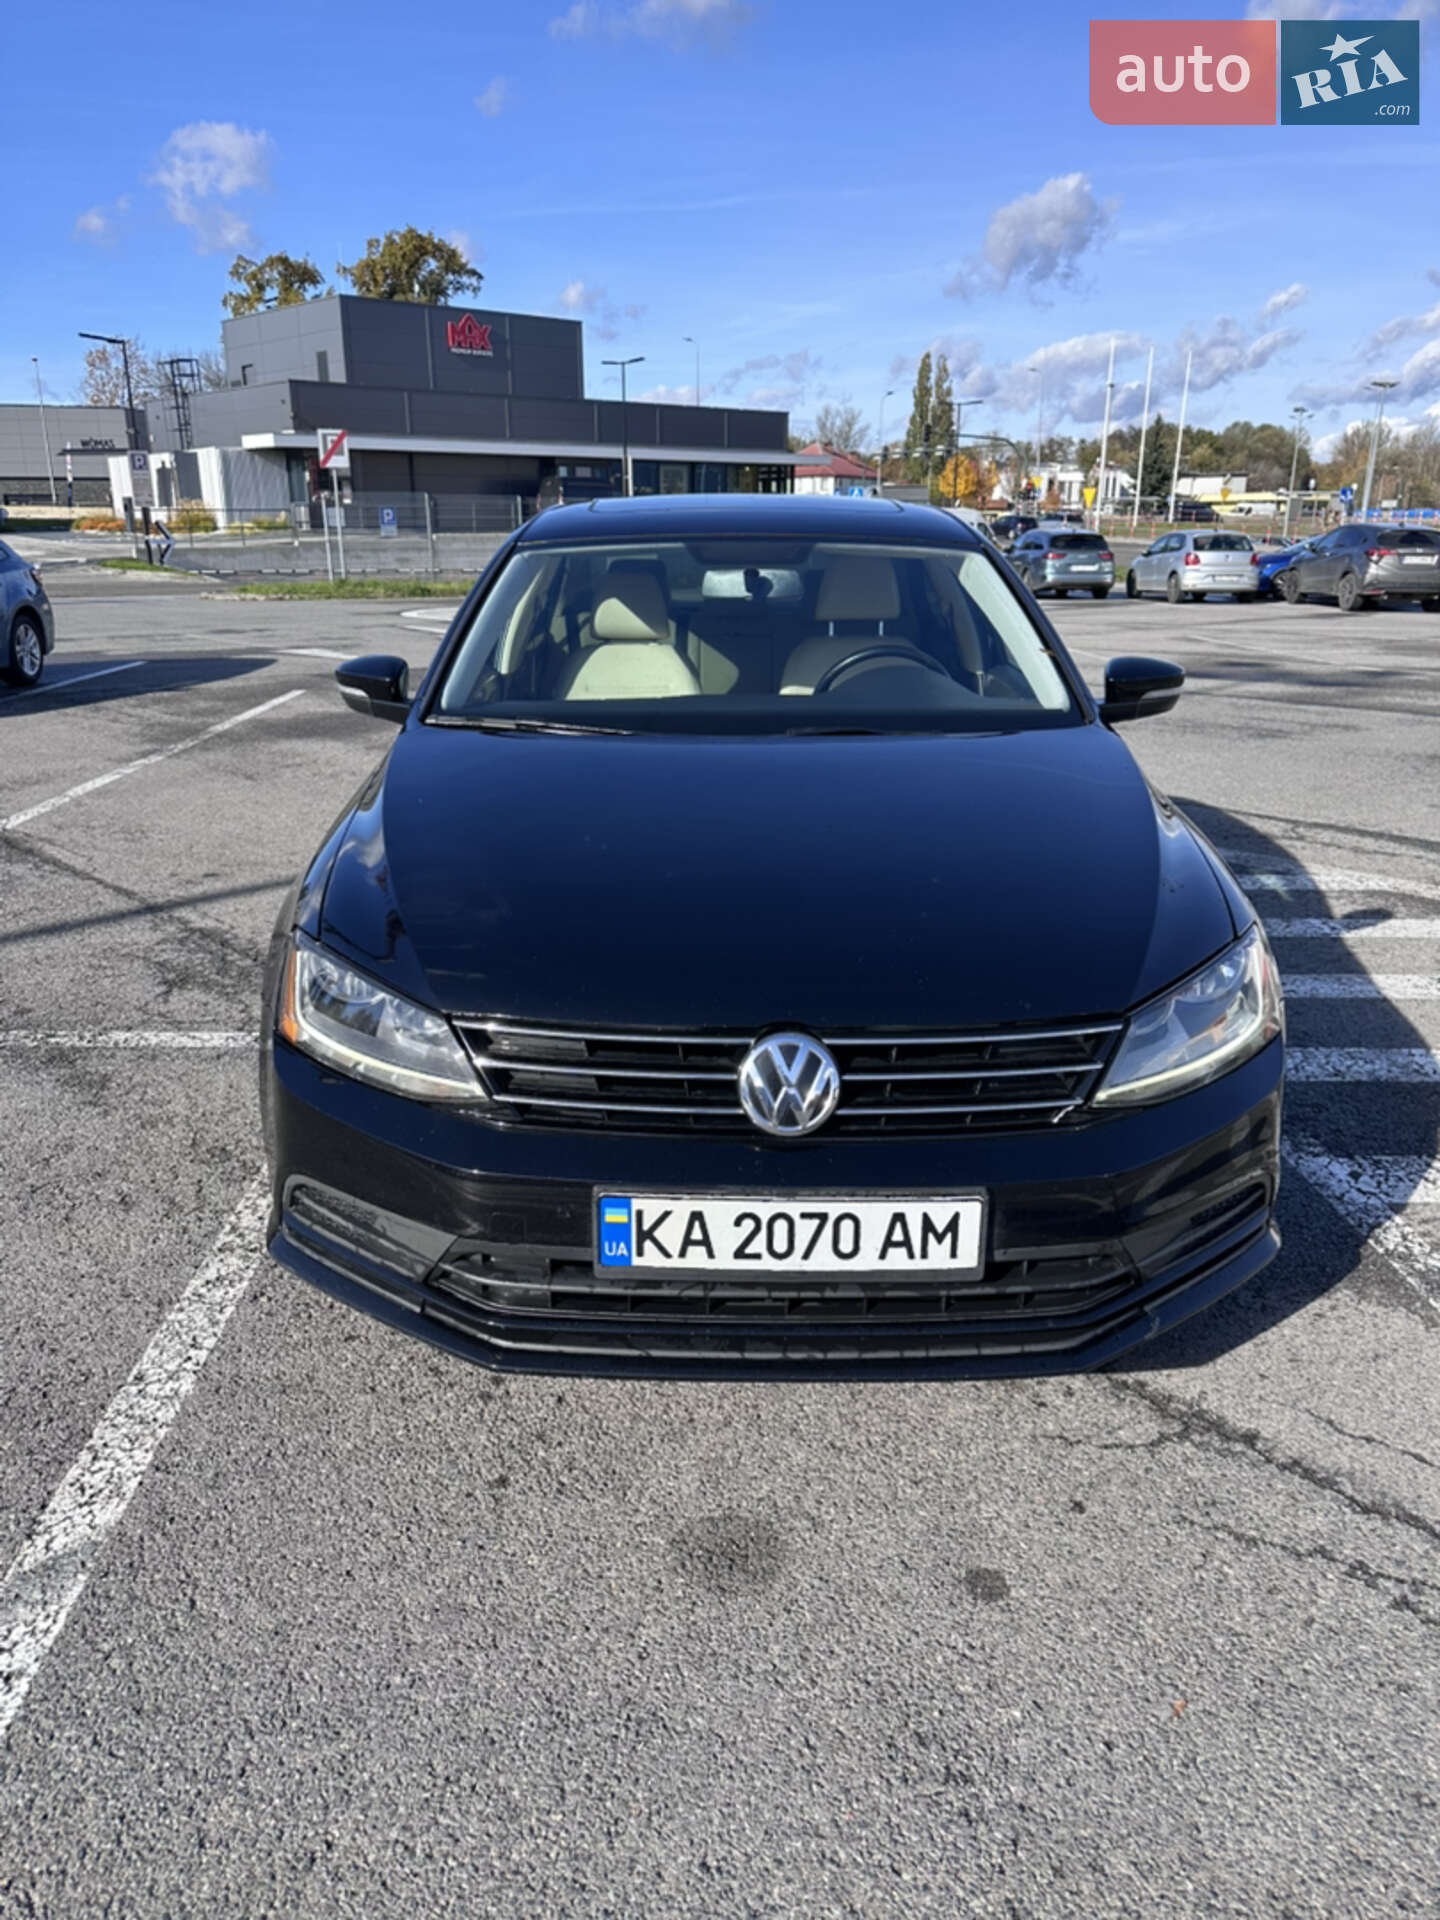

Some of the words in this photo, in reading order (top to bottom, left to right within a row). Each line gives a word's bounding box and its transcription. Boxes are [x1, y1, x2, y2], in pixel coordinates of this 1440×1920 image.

[134, 455, 144, 469] P
[383, 509, 393, 523] P
[636, 1209, 716, 1261] KA
[733, 1212, 862, 1261] 2070
[878, 1211, 961, 1260] AM
[604, 1241, 629, 1258] UA
